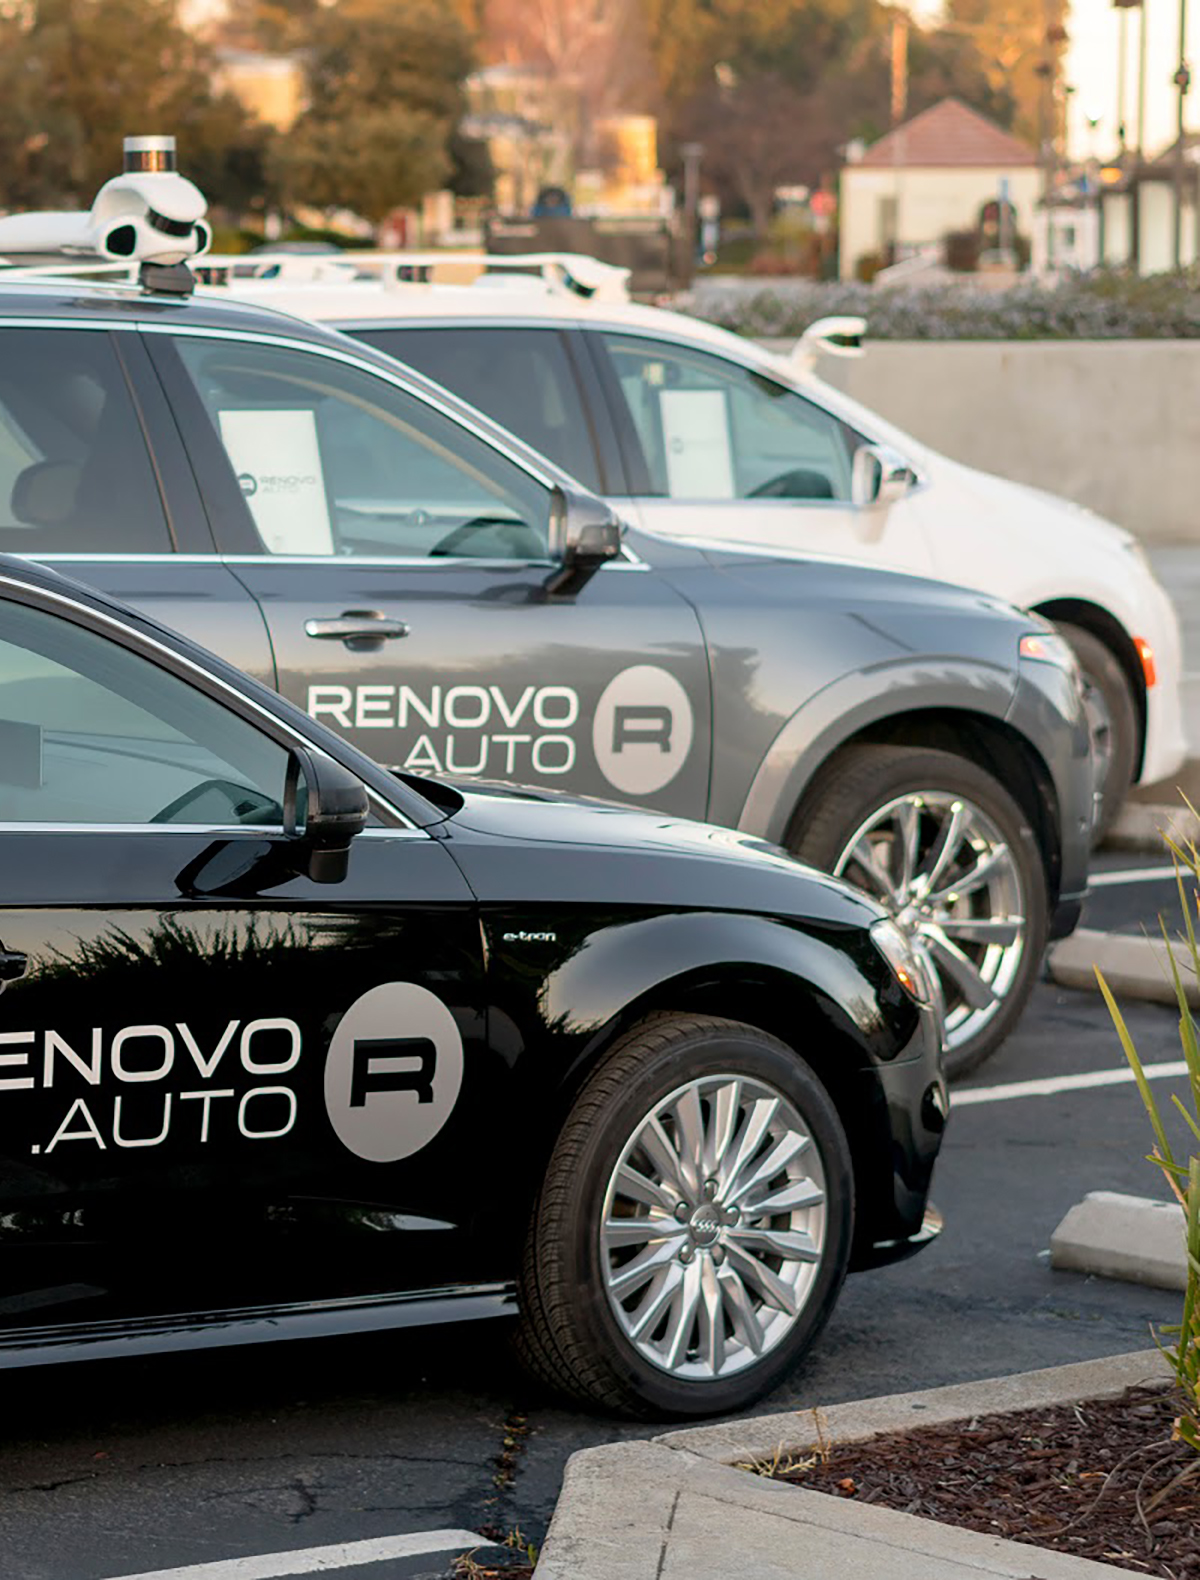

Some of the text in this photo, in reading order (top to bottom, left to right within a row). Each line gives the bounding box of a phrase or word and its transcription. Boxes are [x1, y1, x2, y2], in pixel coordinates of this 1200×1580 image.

[308, 685, 579, 728] RENOVO
[611, 705, 673, 754] R
[503, 931, 556, 941] e-tron
[349, 1036, 437, 1108] R
[31, 1086, 297, 1154] .AUTO
